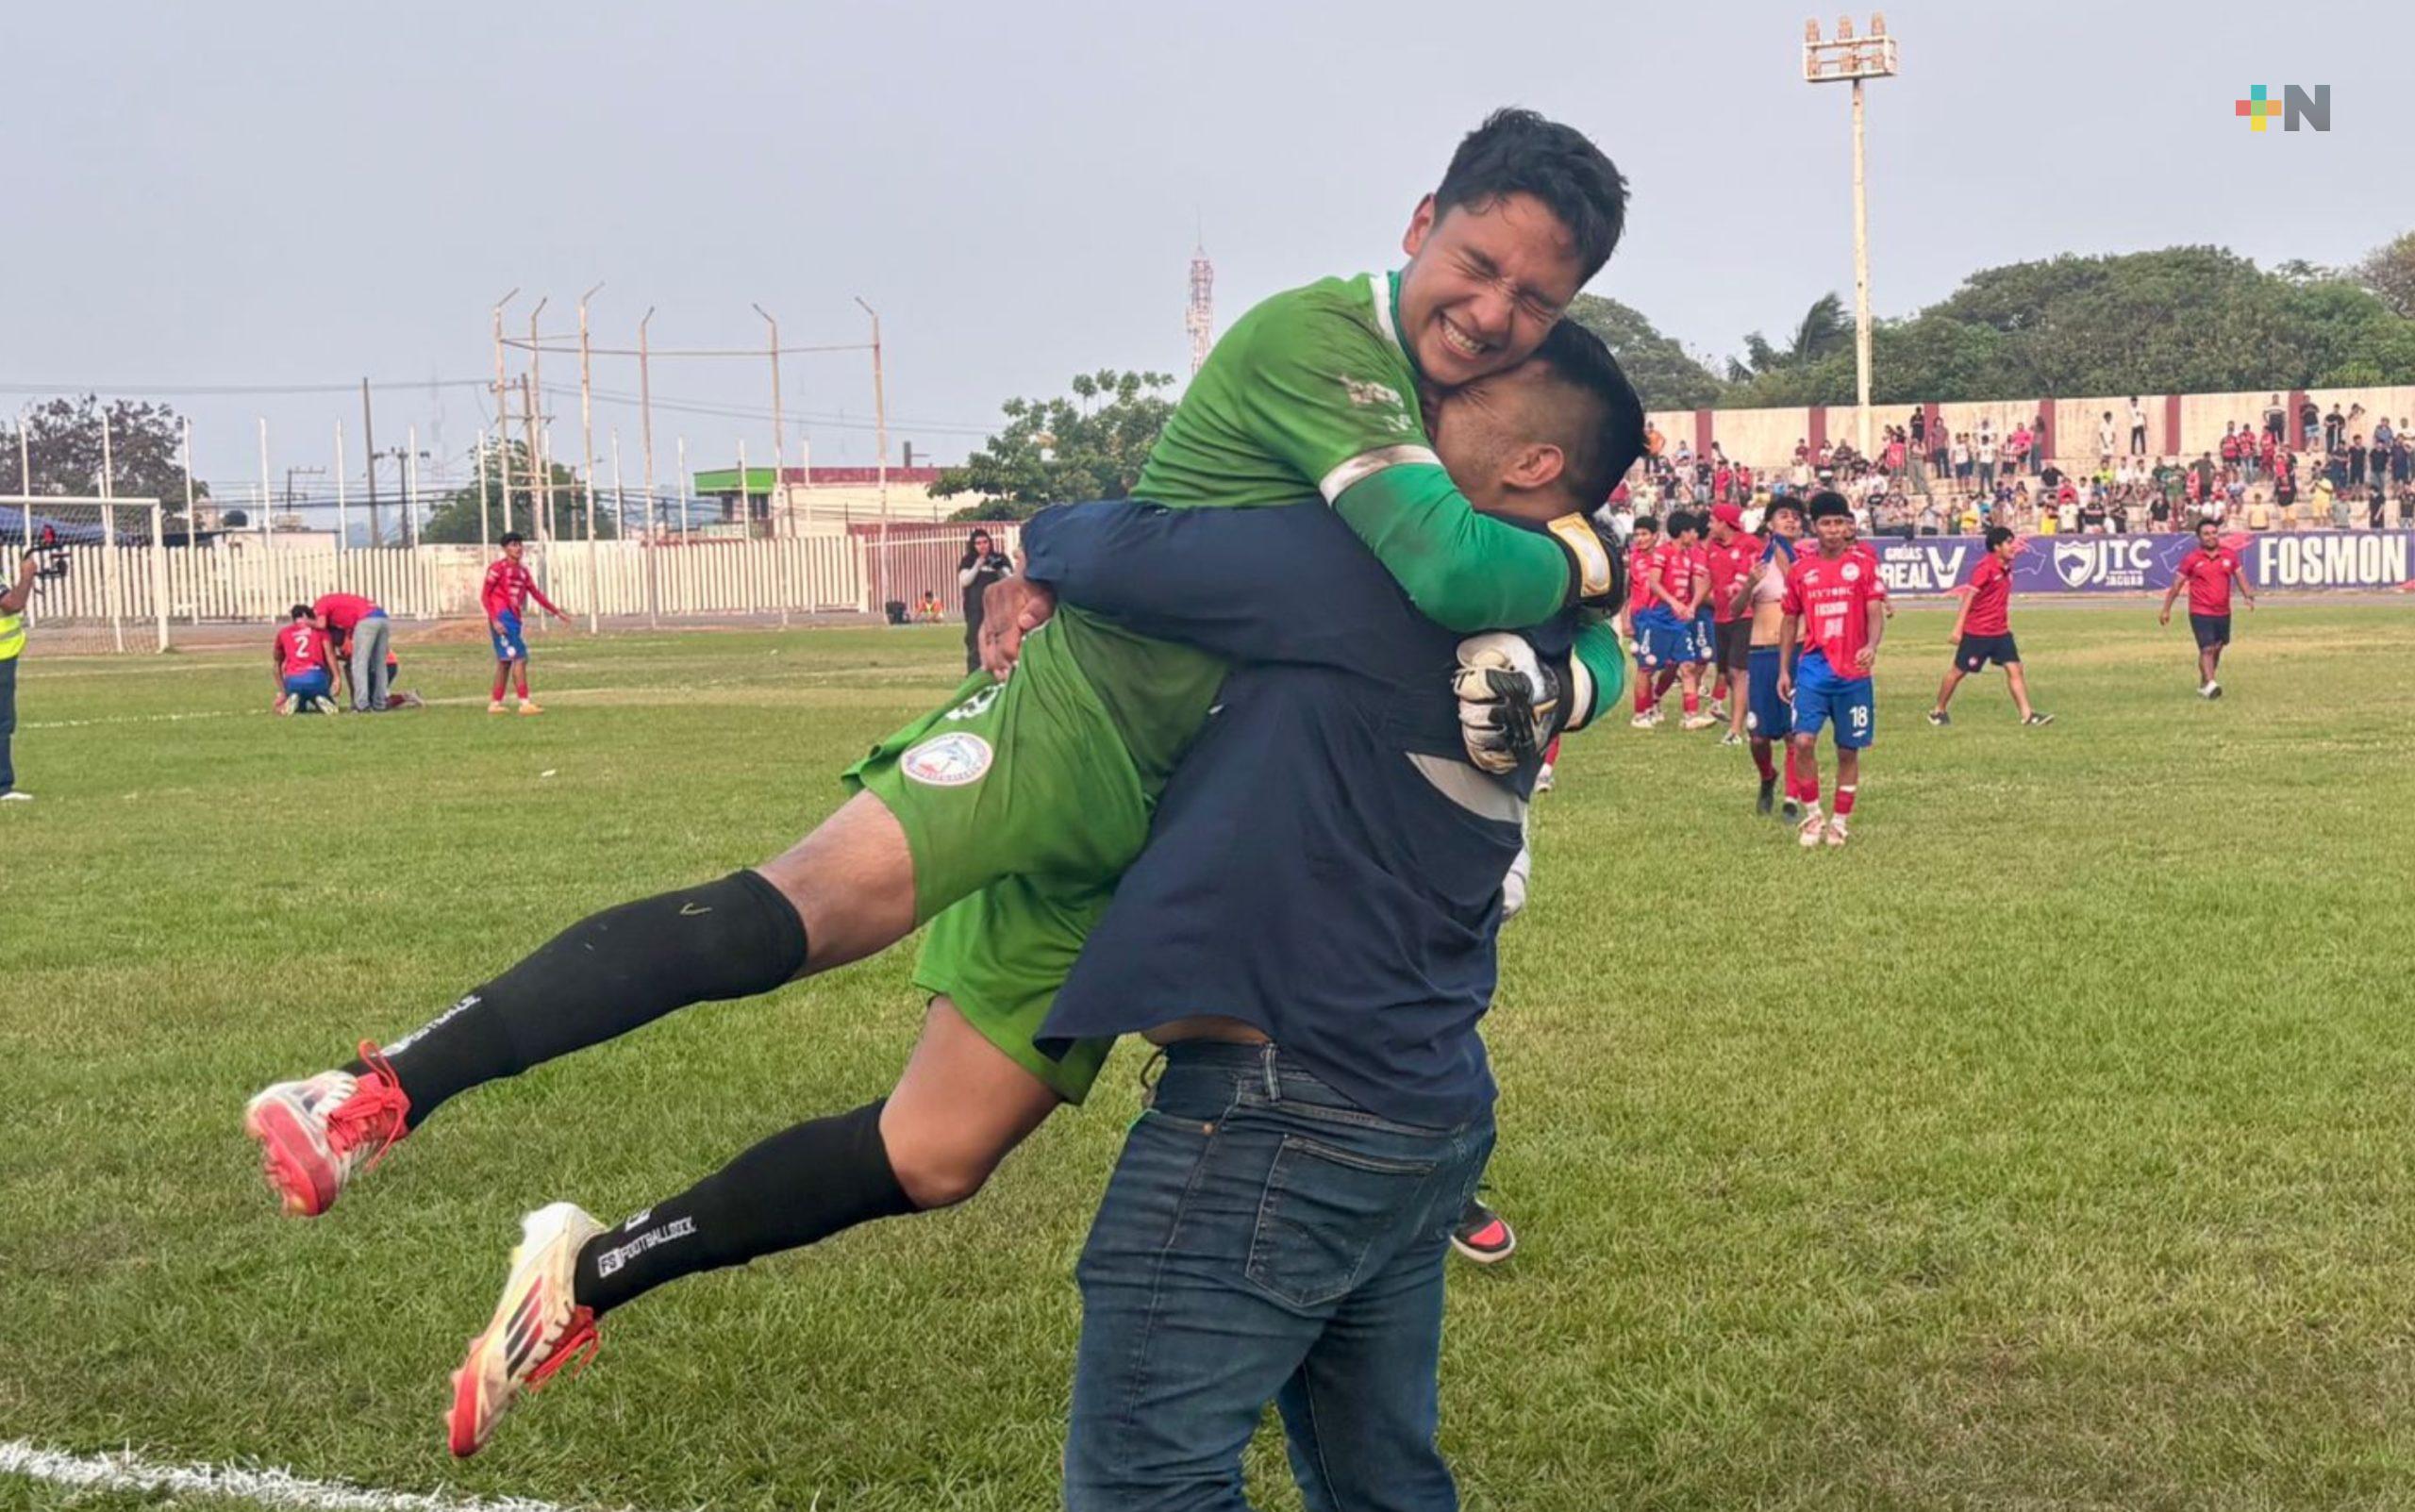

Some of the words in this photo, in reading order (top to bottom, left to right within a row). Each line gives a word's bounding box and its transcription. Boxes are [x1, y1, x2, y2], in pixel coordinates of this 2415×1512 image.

[2092, 539, 2152, 583] JTC
[2259, 535, 2406, 585] FOSMON
[294, 636, 309, 657] 2
[1849, 706, 1868, 727] 18
